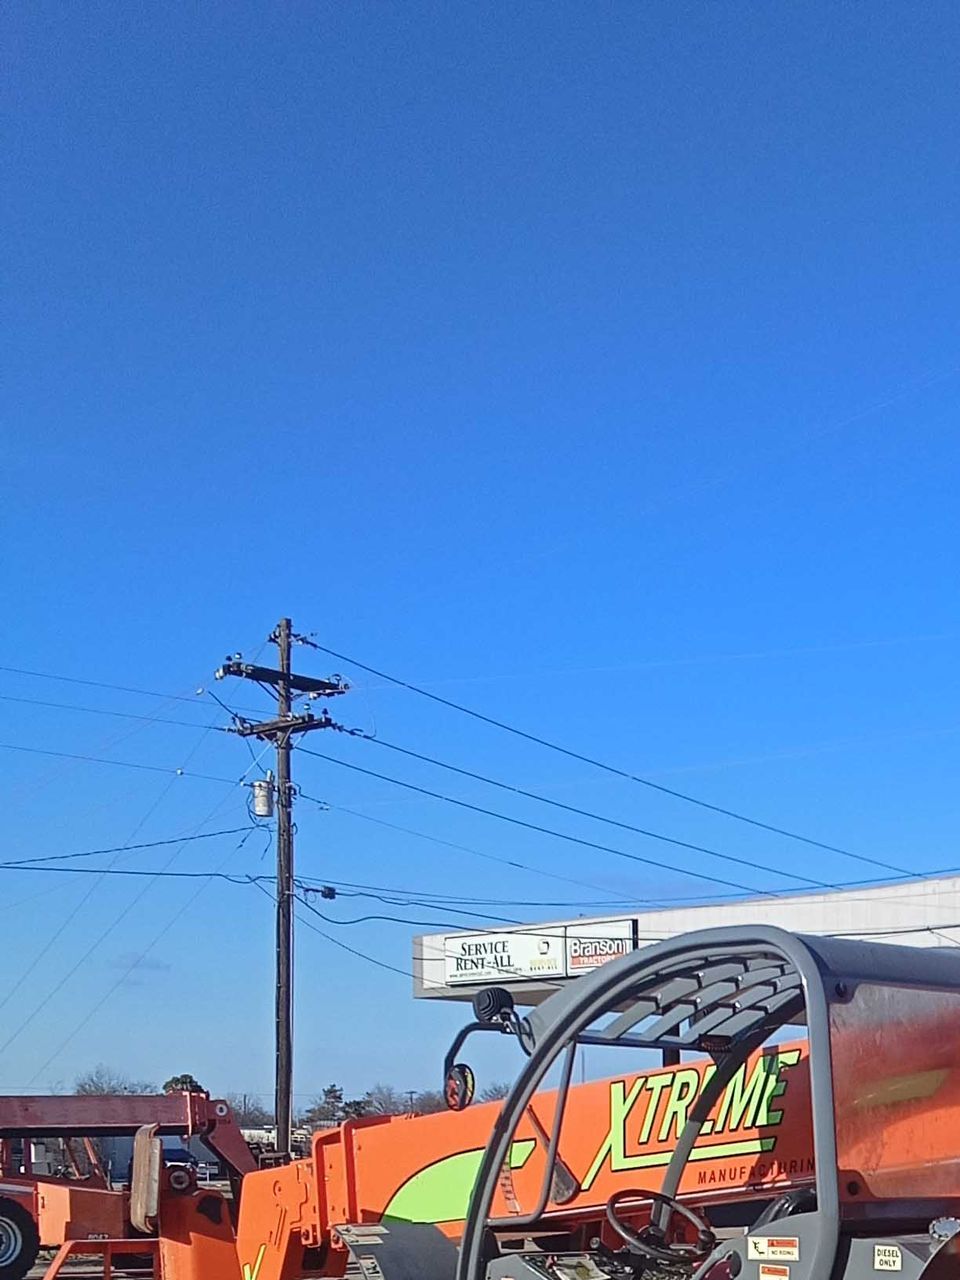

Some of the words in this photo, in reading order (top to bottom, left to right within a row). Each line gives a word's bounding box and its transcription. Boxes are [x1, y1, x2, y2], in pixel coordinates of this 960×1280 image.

[460, 941, 509, 957] SERVICE
[571, 938, 624, 957] Branson
[455, 955, 515, 972] RENT-ALL
[697, 1153, 816, 1185] MANUFACTURIN
[876, 1248, 900, 1258] DIESEL
[879, 1259, 897, 1267] ONLY
